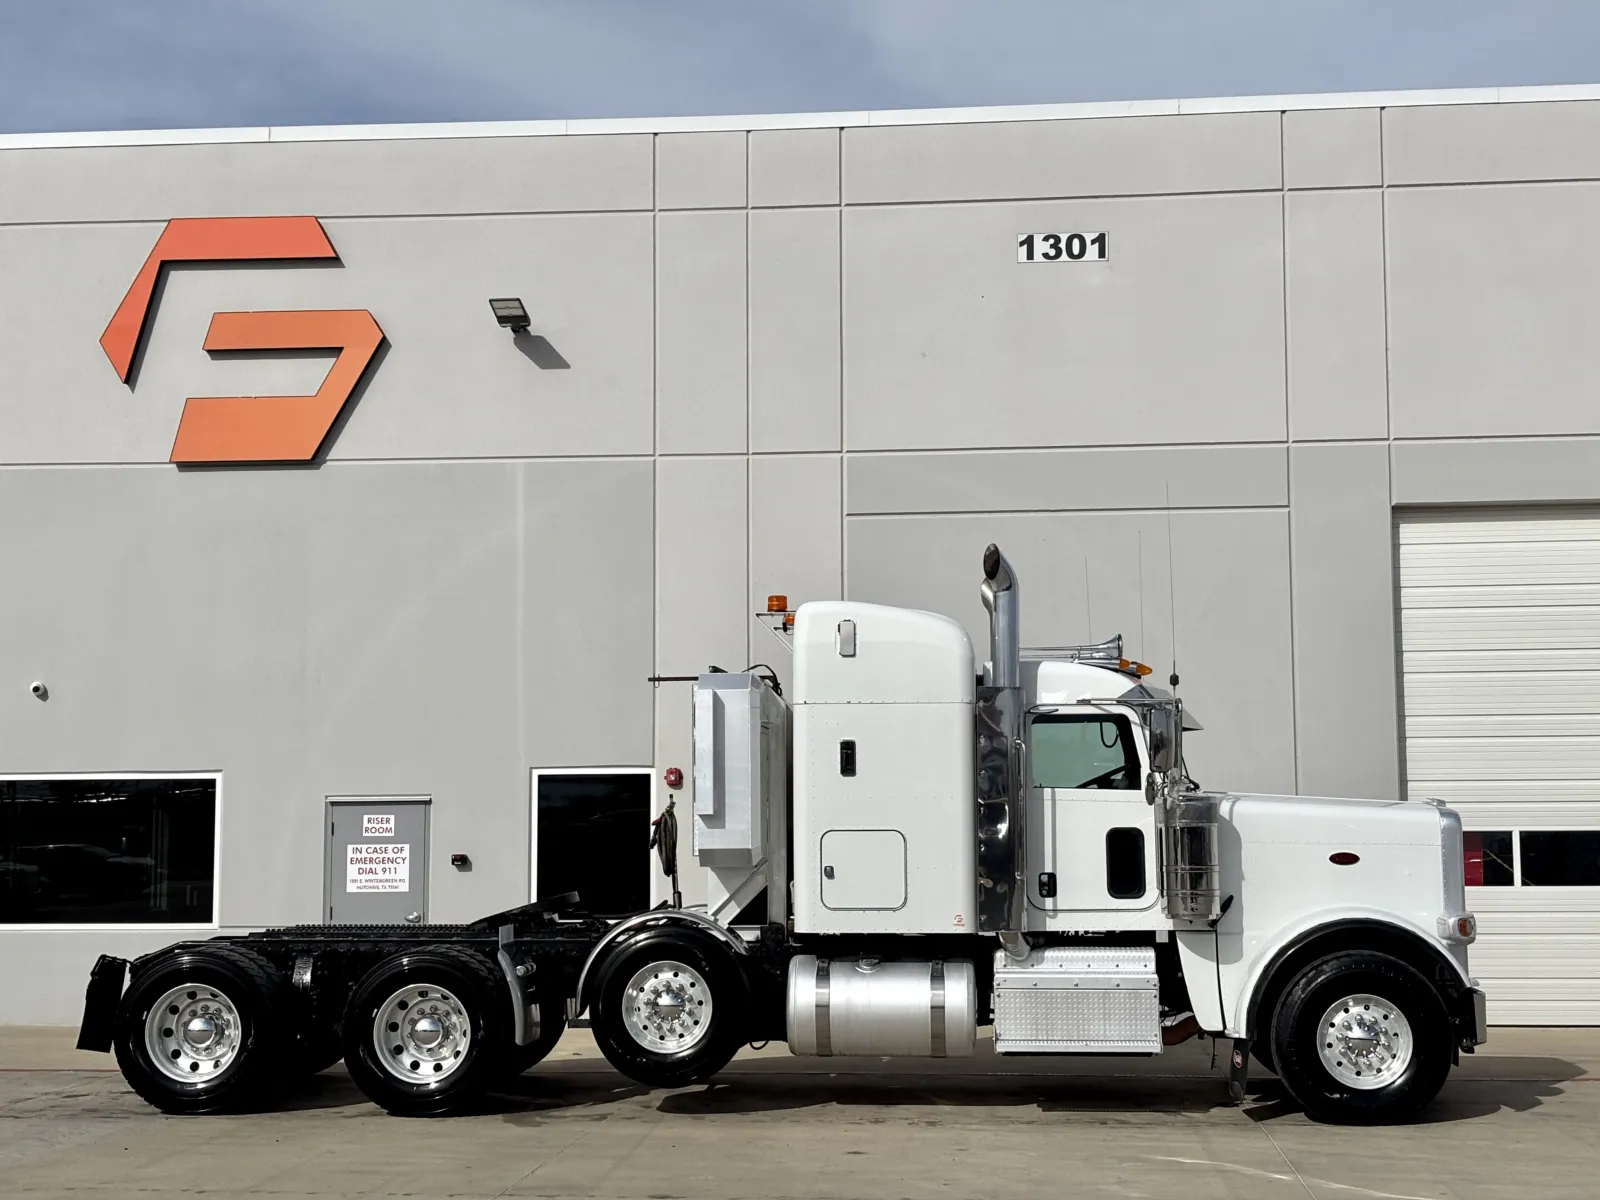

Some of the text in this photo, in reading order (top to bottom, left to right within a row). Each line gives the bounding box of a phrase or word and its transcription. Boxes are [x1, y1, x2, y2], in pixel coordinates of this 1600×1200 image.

[1018, 232, 1106, 261] 1301
[367, 817, 391, 825] RISER
[364, 826, 393, 834] ROOM
[352, 846, 405, 855] IN CASE OF
[350, 857, 407, 865] EMERGENCY
[357, 867, 397, 875] DIAL 911
